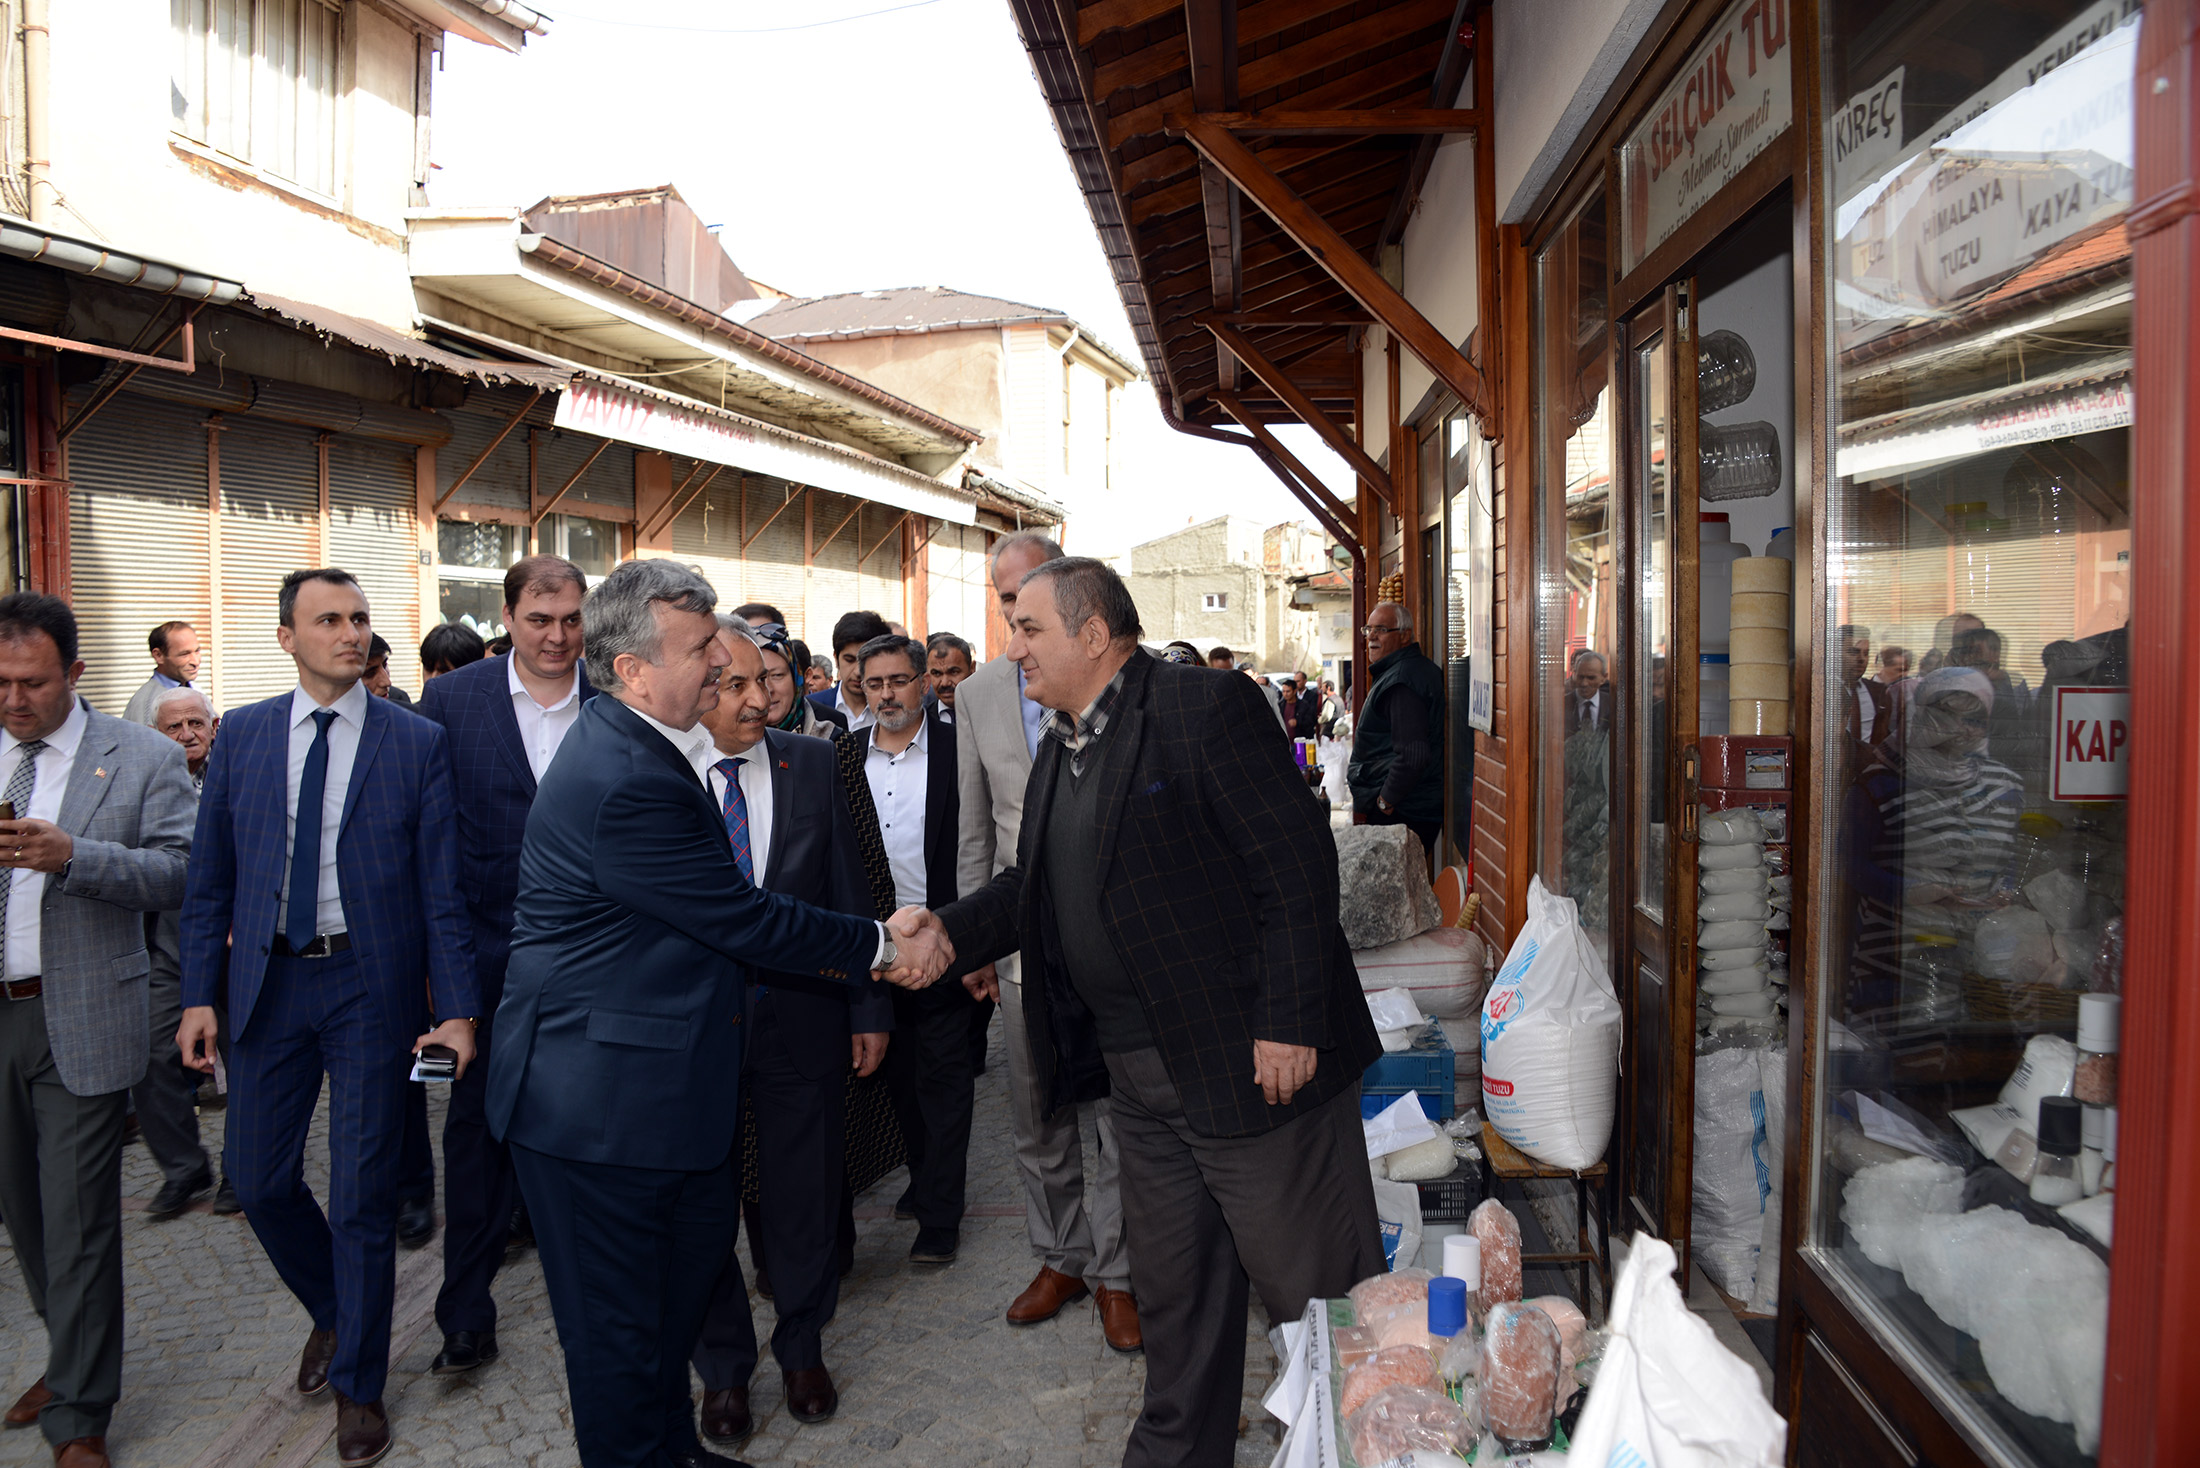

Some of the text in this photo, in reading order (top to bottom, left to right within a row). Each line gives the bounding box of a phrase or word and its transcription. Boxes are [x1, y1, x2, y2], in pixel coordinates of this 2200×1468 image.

[1651, 0, 1789, 183] SELÇUK TU
[1835, 80, 1899, 163] KİREÇ
[1678, 138, 1723, 208] Mehmet
[1922, 177, 2005, 245] HİMALAYA
[2023, 182, 2083, 239] KAYA
[1940, 237, 1981, 280] TUZU
[569, 383, 656, 437] YAVUZ
[2066, 719, 2127, 762] KAP
[1492, 1083, 1511, 1096] TUZU
